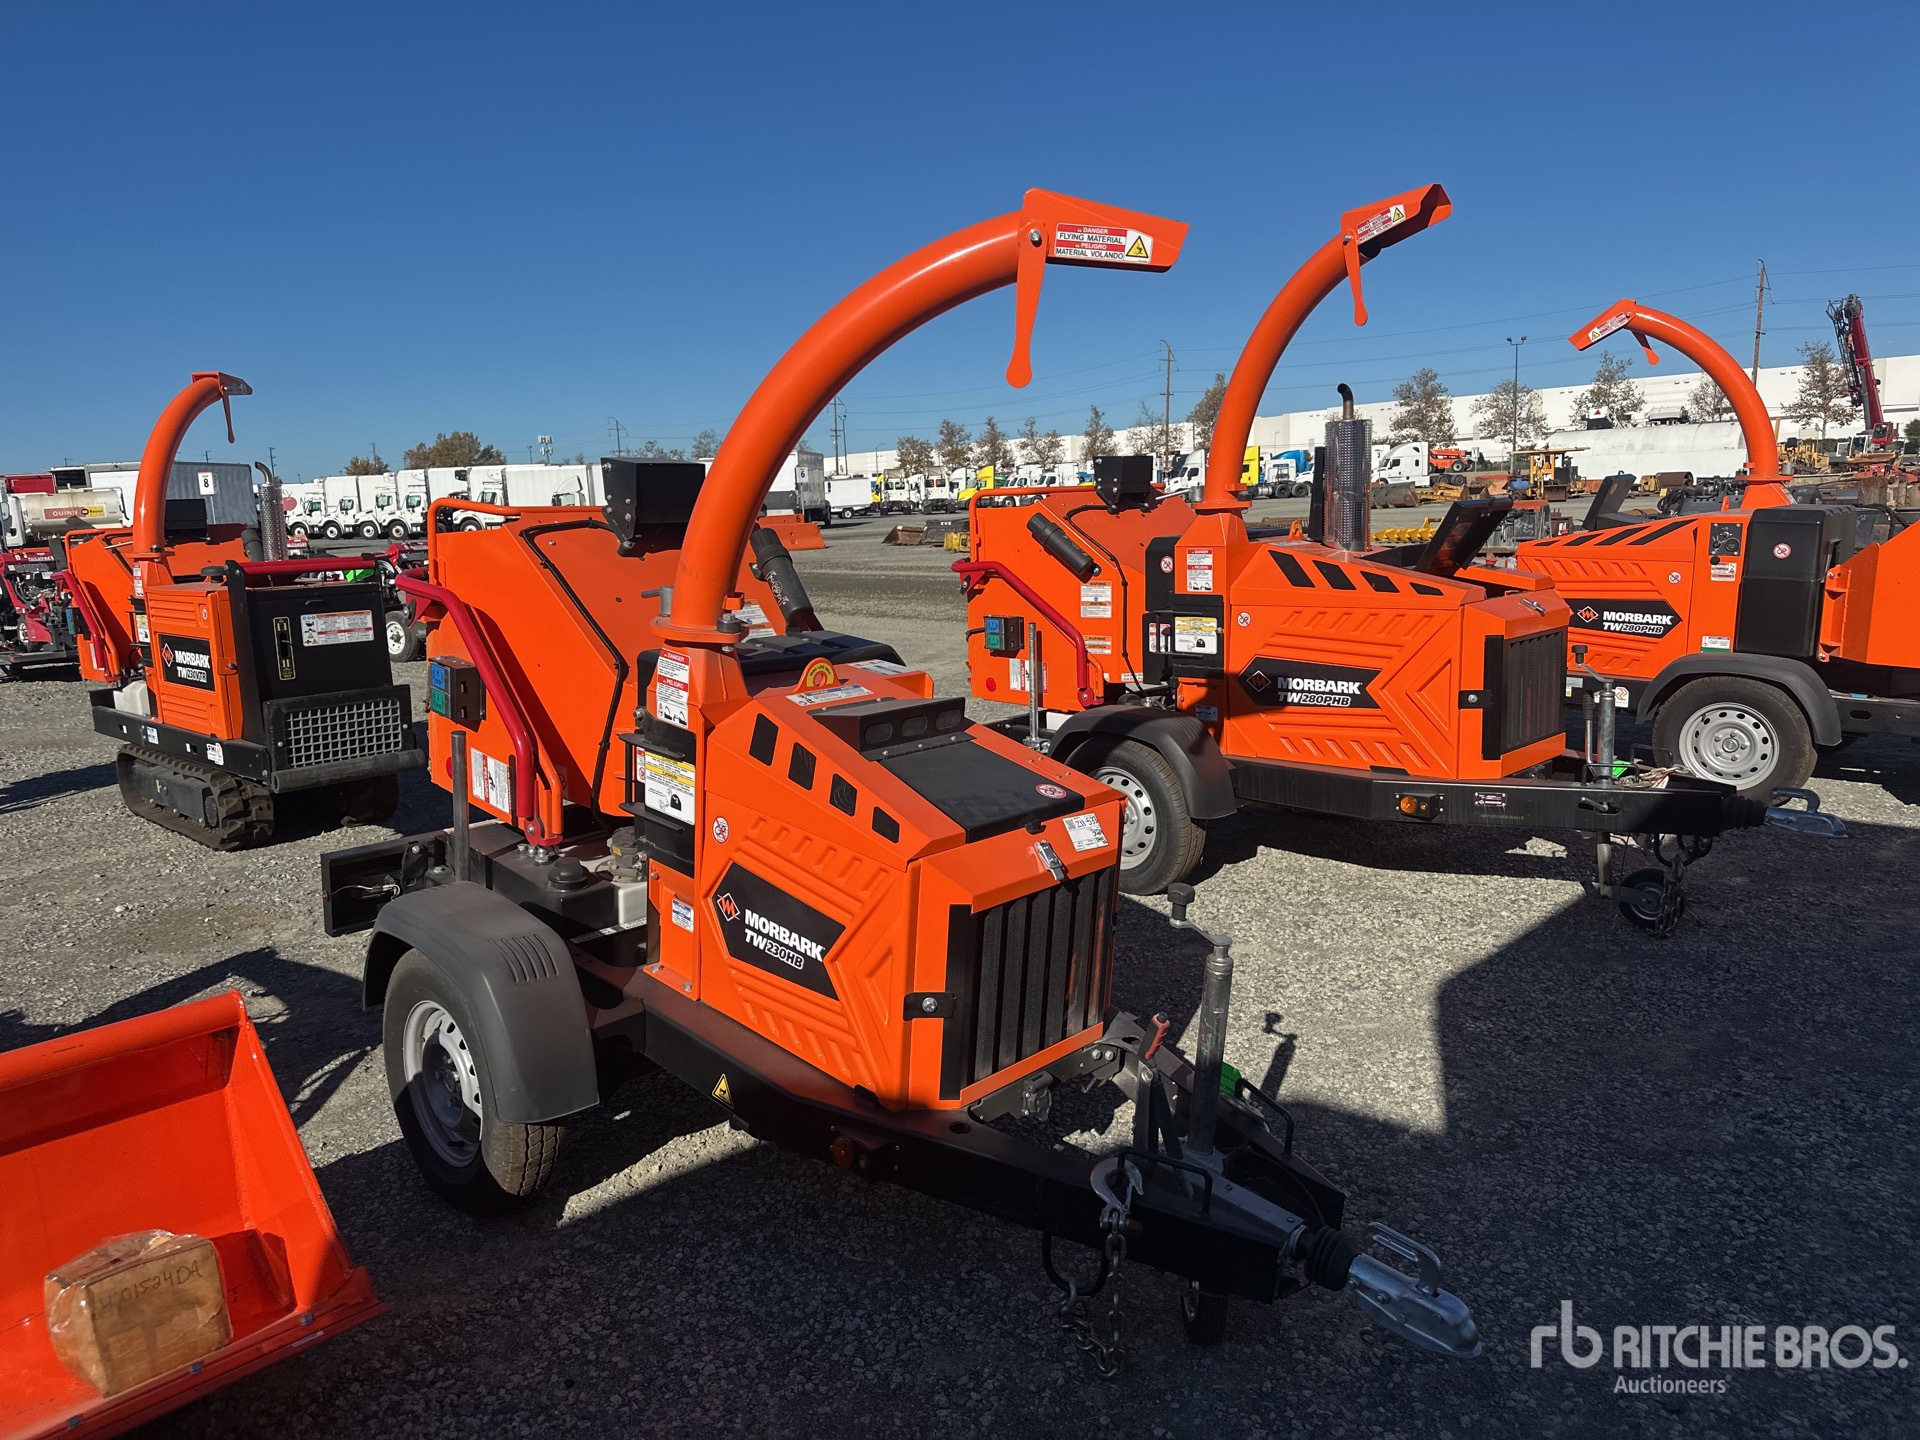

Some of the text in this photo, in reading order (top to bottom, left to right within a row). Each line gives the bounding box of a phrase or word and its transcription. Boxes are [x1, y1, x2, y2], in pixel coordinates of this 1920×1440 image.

[1060, 232, 1122, 244] FLYING MATERIAL
[1056, 248, 1124, 259] MATERIAL VOLANDO
[801, 470, 806, 478] 6
[203, 478, 209, 489] 8
[1603, 611, 1672, 625] MORBARK
[1603, 622, 1664, 634] TW280PHB
[175, 650, 211, 668] MORBARK
[667, 652, 685, 663] DANGER
[666, 679, 685, 689] PELIGRO
[1278, 676, 1361, 694] MORBARK
[1278, 692, 1351, 706] TW280PHB
[744, 908, 823, 962] MORBARK
[744, 928, 805, 970] TW230HB
